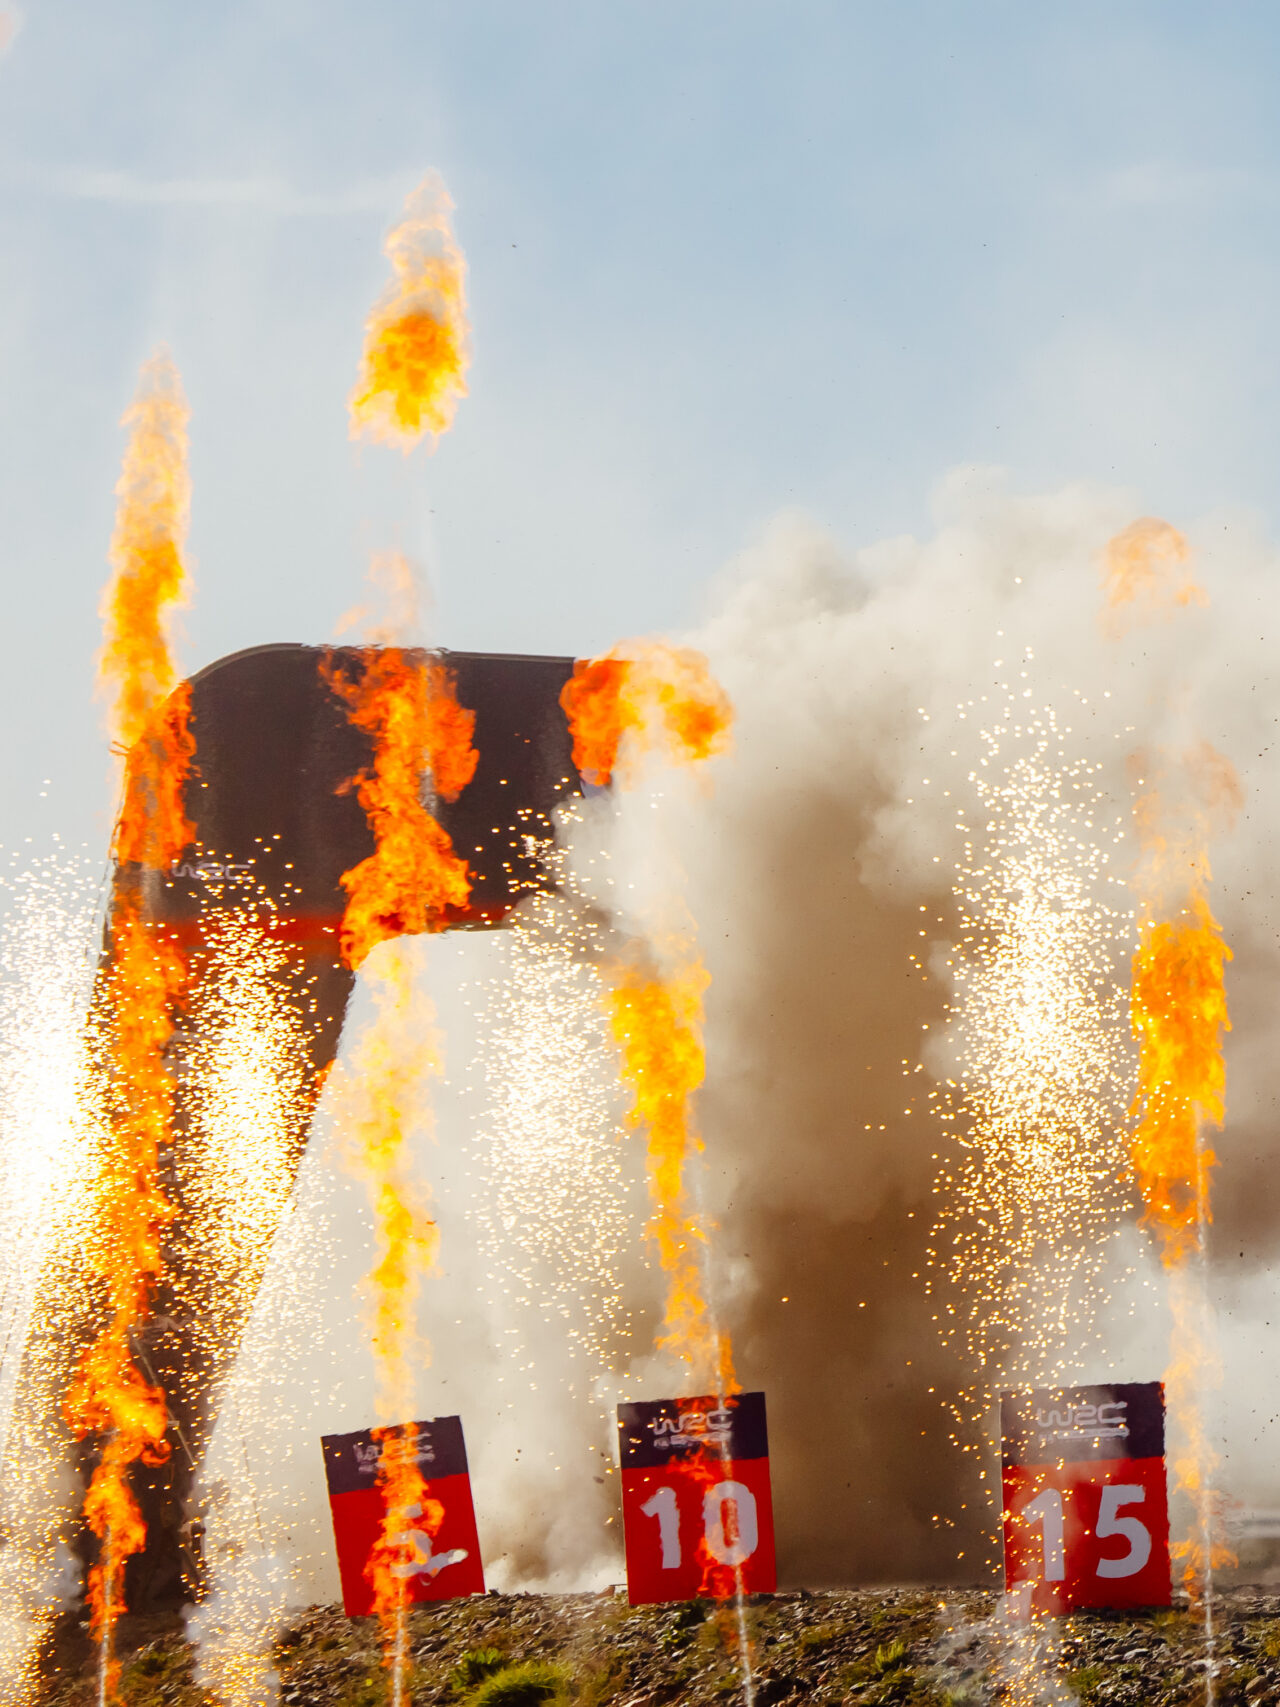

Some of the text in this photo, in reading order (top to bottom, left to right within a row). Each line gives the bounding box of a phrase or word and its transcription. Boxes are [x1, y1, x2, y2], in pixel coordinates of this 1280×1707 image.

[1037, 1401, 1128, 1427] WRC
[640, 1480, 758, 1569] 10
[1022, 1484, 1152, 1582] 15
